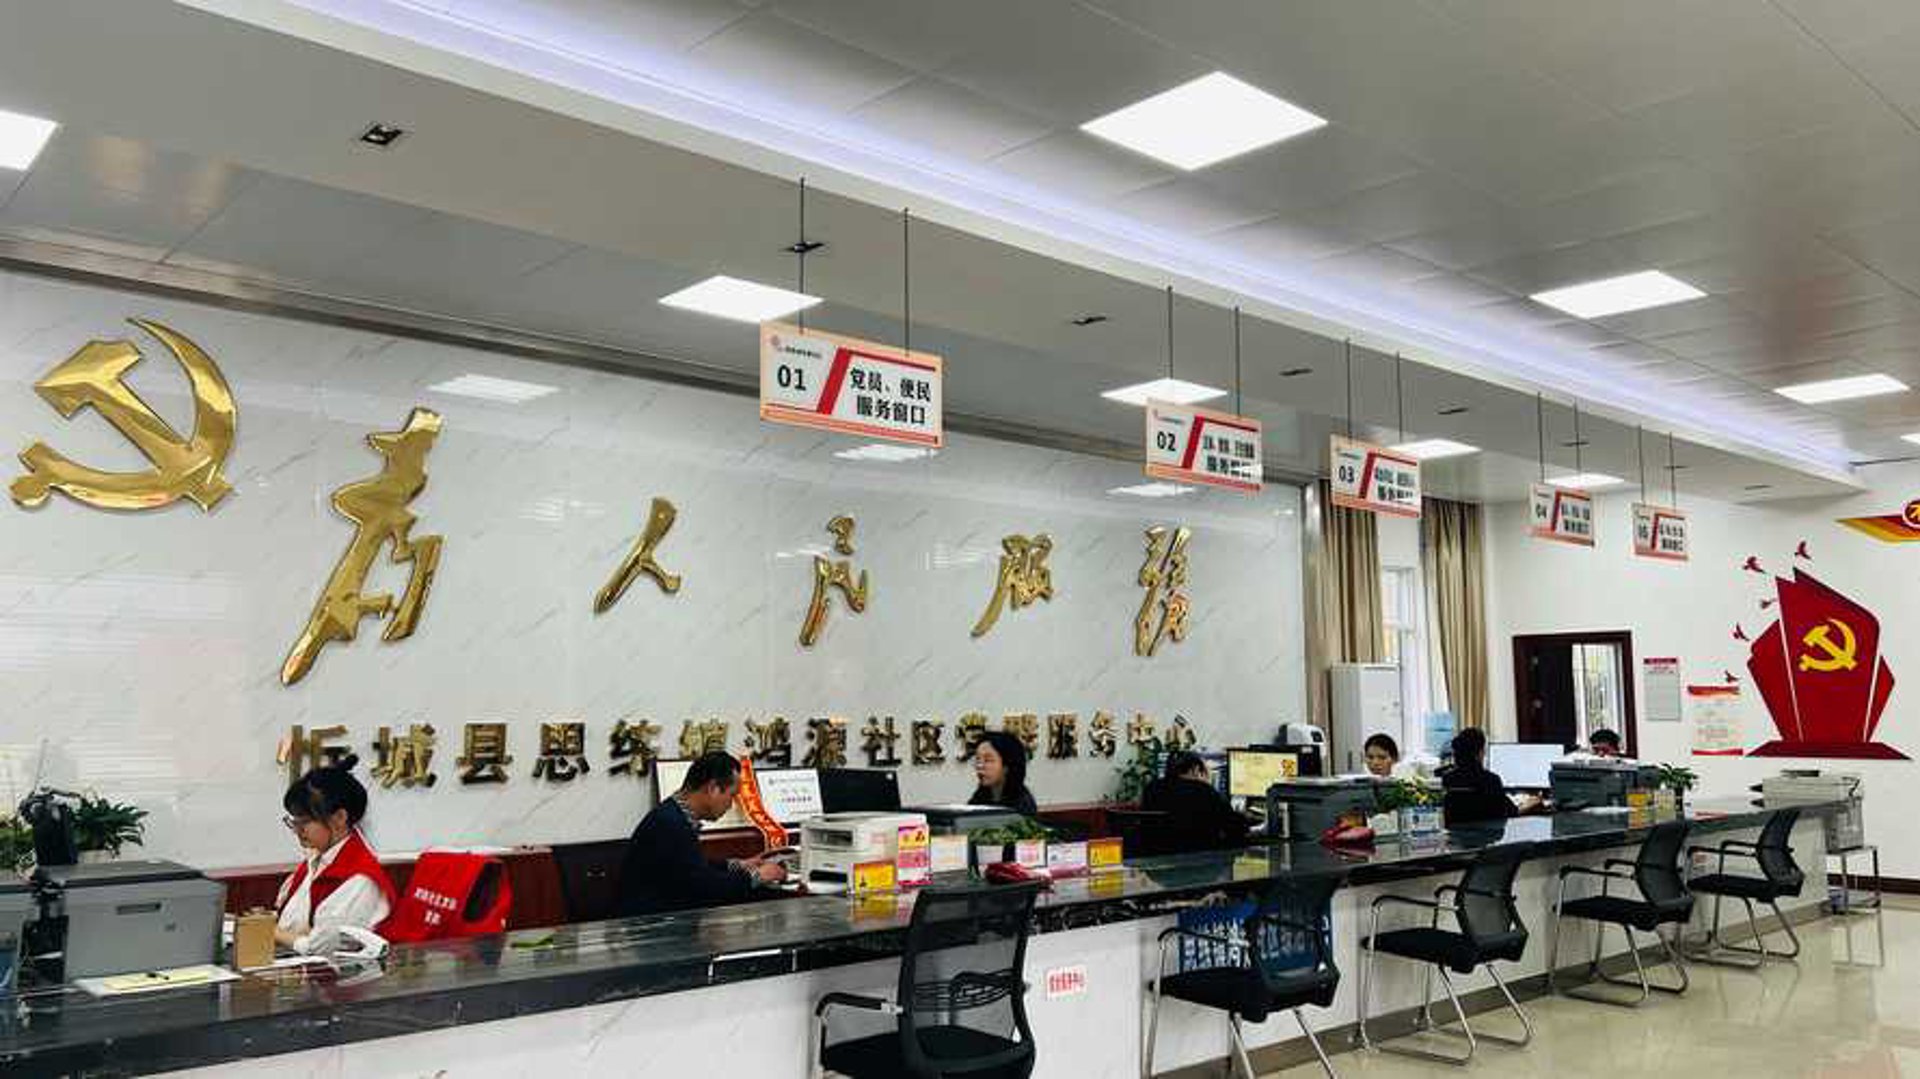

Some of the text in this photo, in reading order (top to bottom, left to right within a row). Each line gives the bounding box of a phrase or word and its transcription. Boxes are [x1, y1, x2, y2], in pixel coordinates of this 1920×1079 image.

[777, 364, 807, 391] 01
[850, 366, 931, 402] 党员、便民
[856, 394, 925, 425] 服务窗口
[1156, 431, 1176, 452] 02
[1338, 465, 1355, 483] 03
